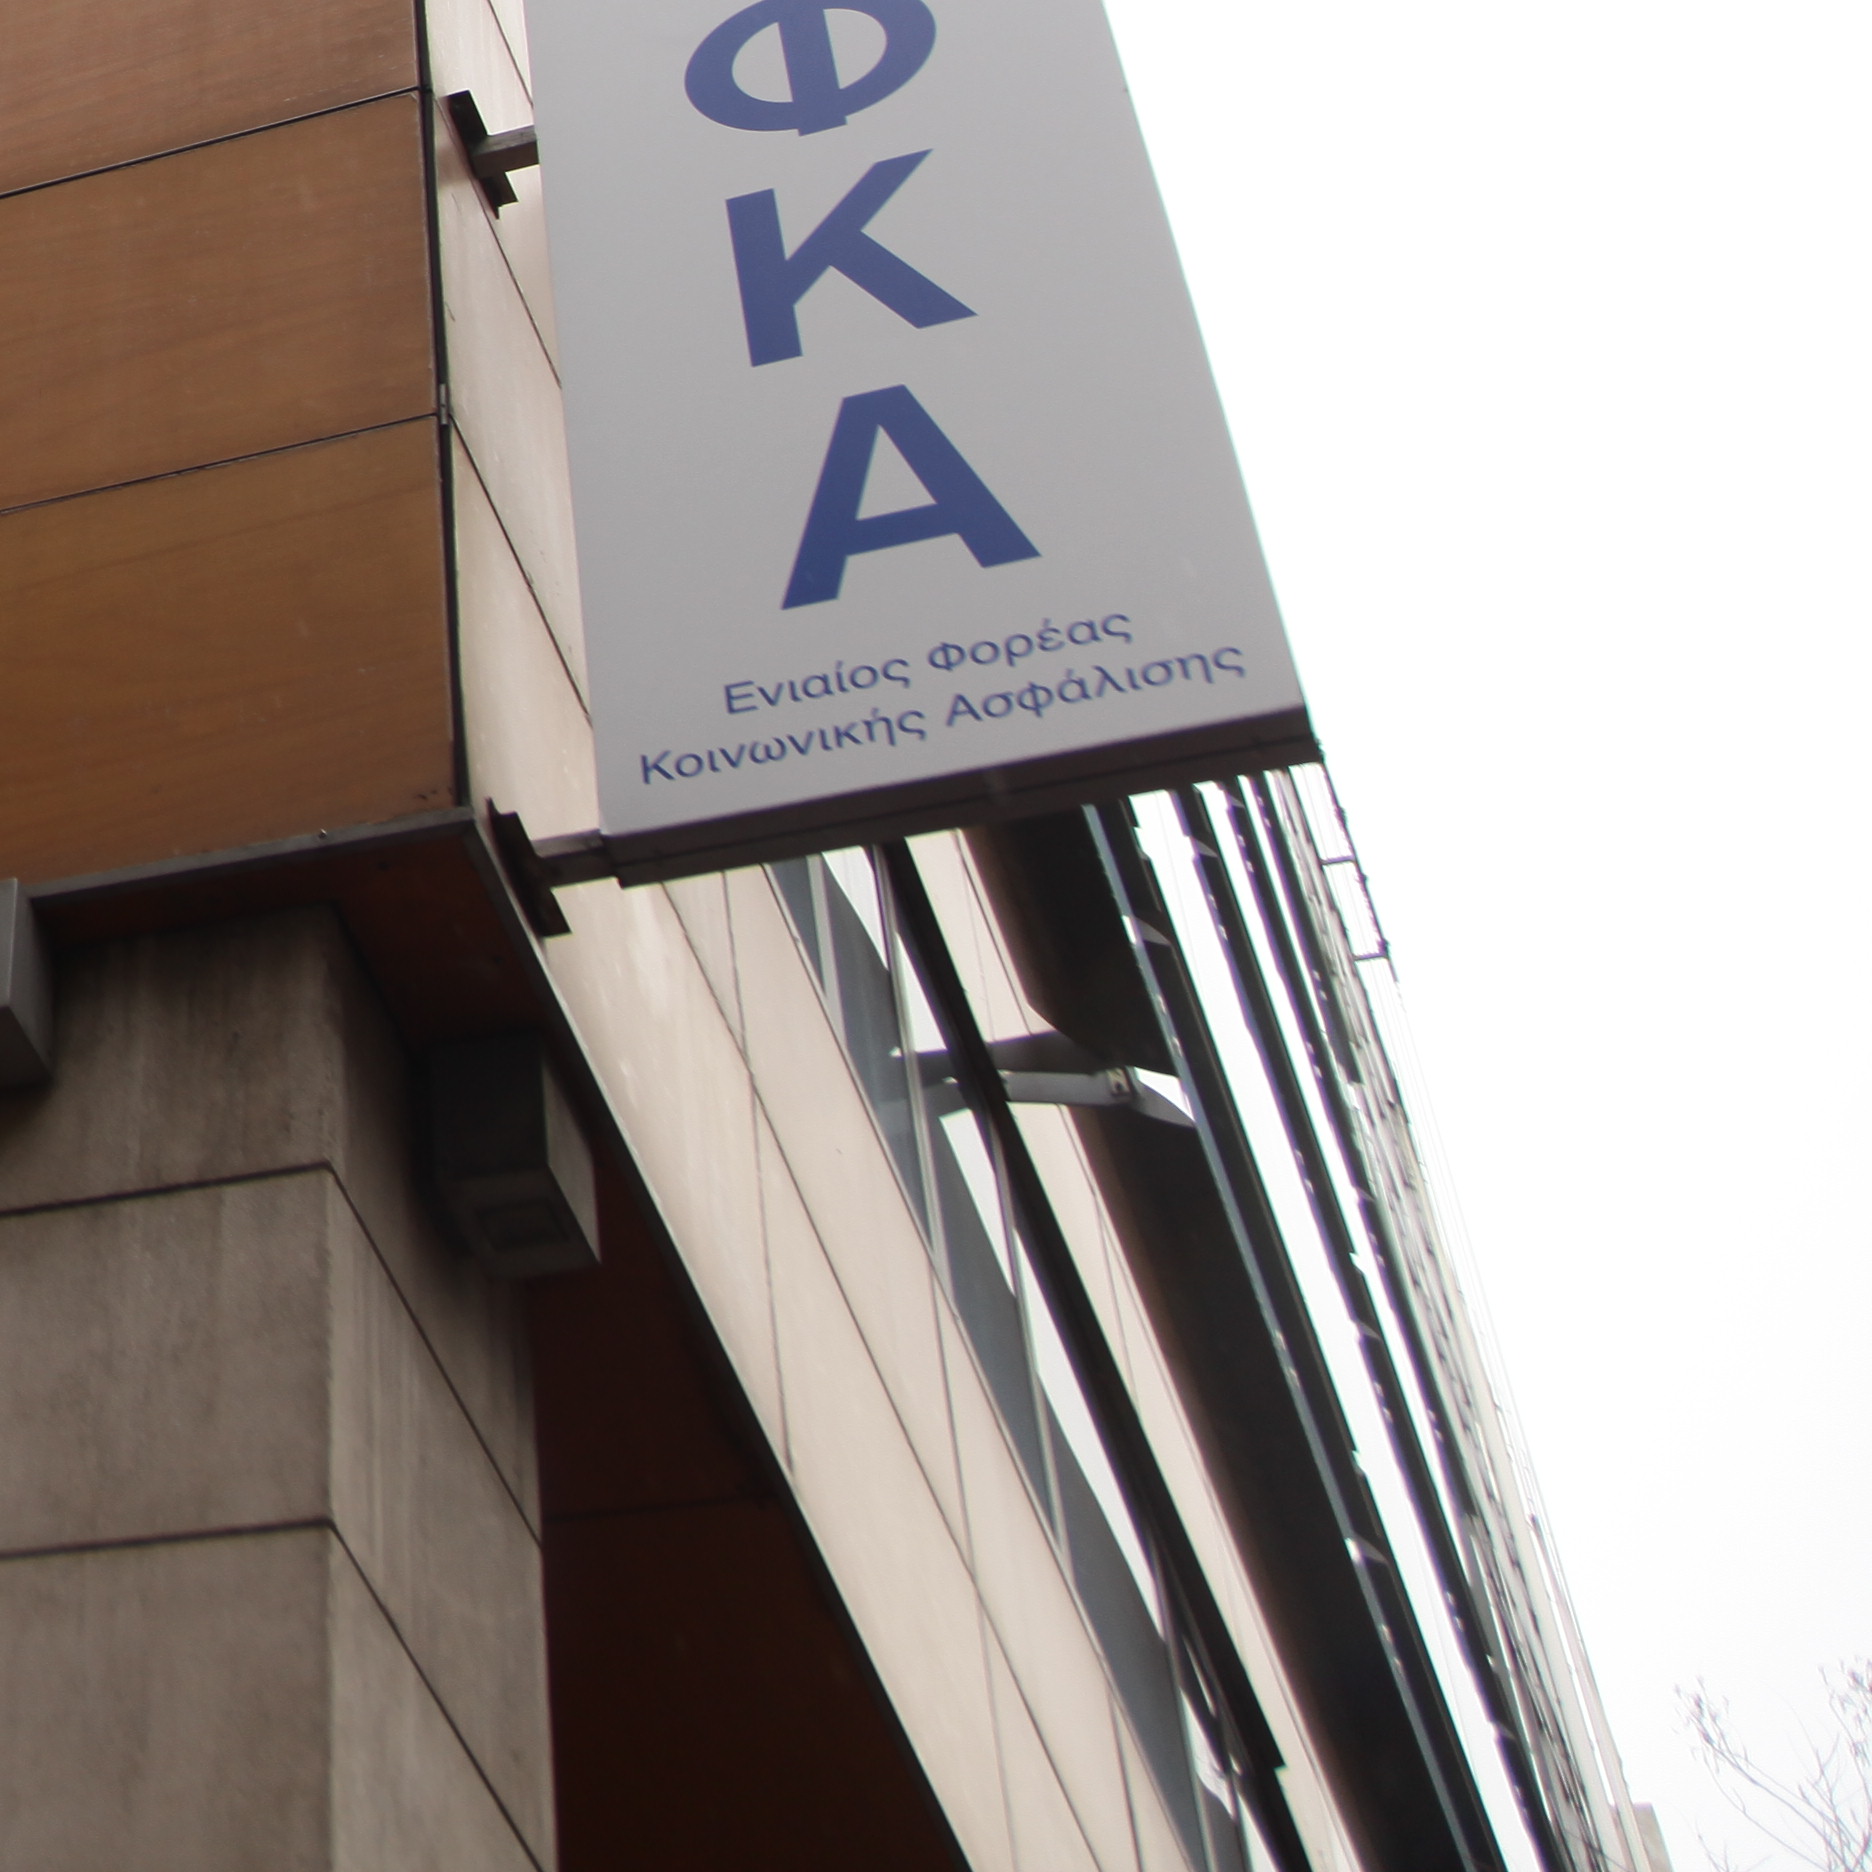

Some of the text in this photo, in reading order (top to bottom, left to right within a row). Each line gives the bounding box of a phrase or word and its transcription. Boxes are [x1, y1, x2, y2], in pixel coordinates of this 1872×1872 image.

[640, 645, 1247, 785] Κοινωνικής Ασφάλισης
[723, 611, 1134, 716] Ενιαίος Φορέας
